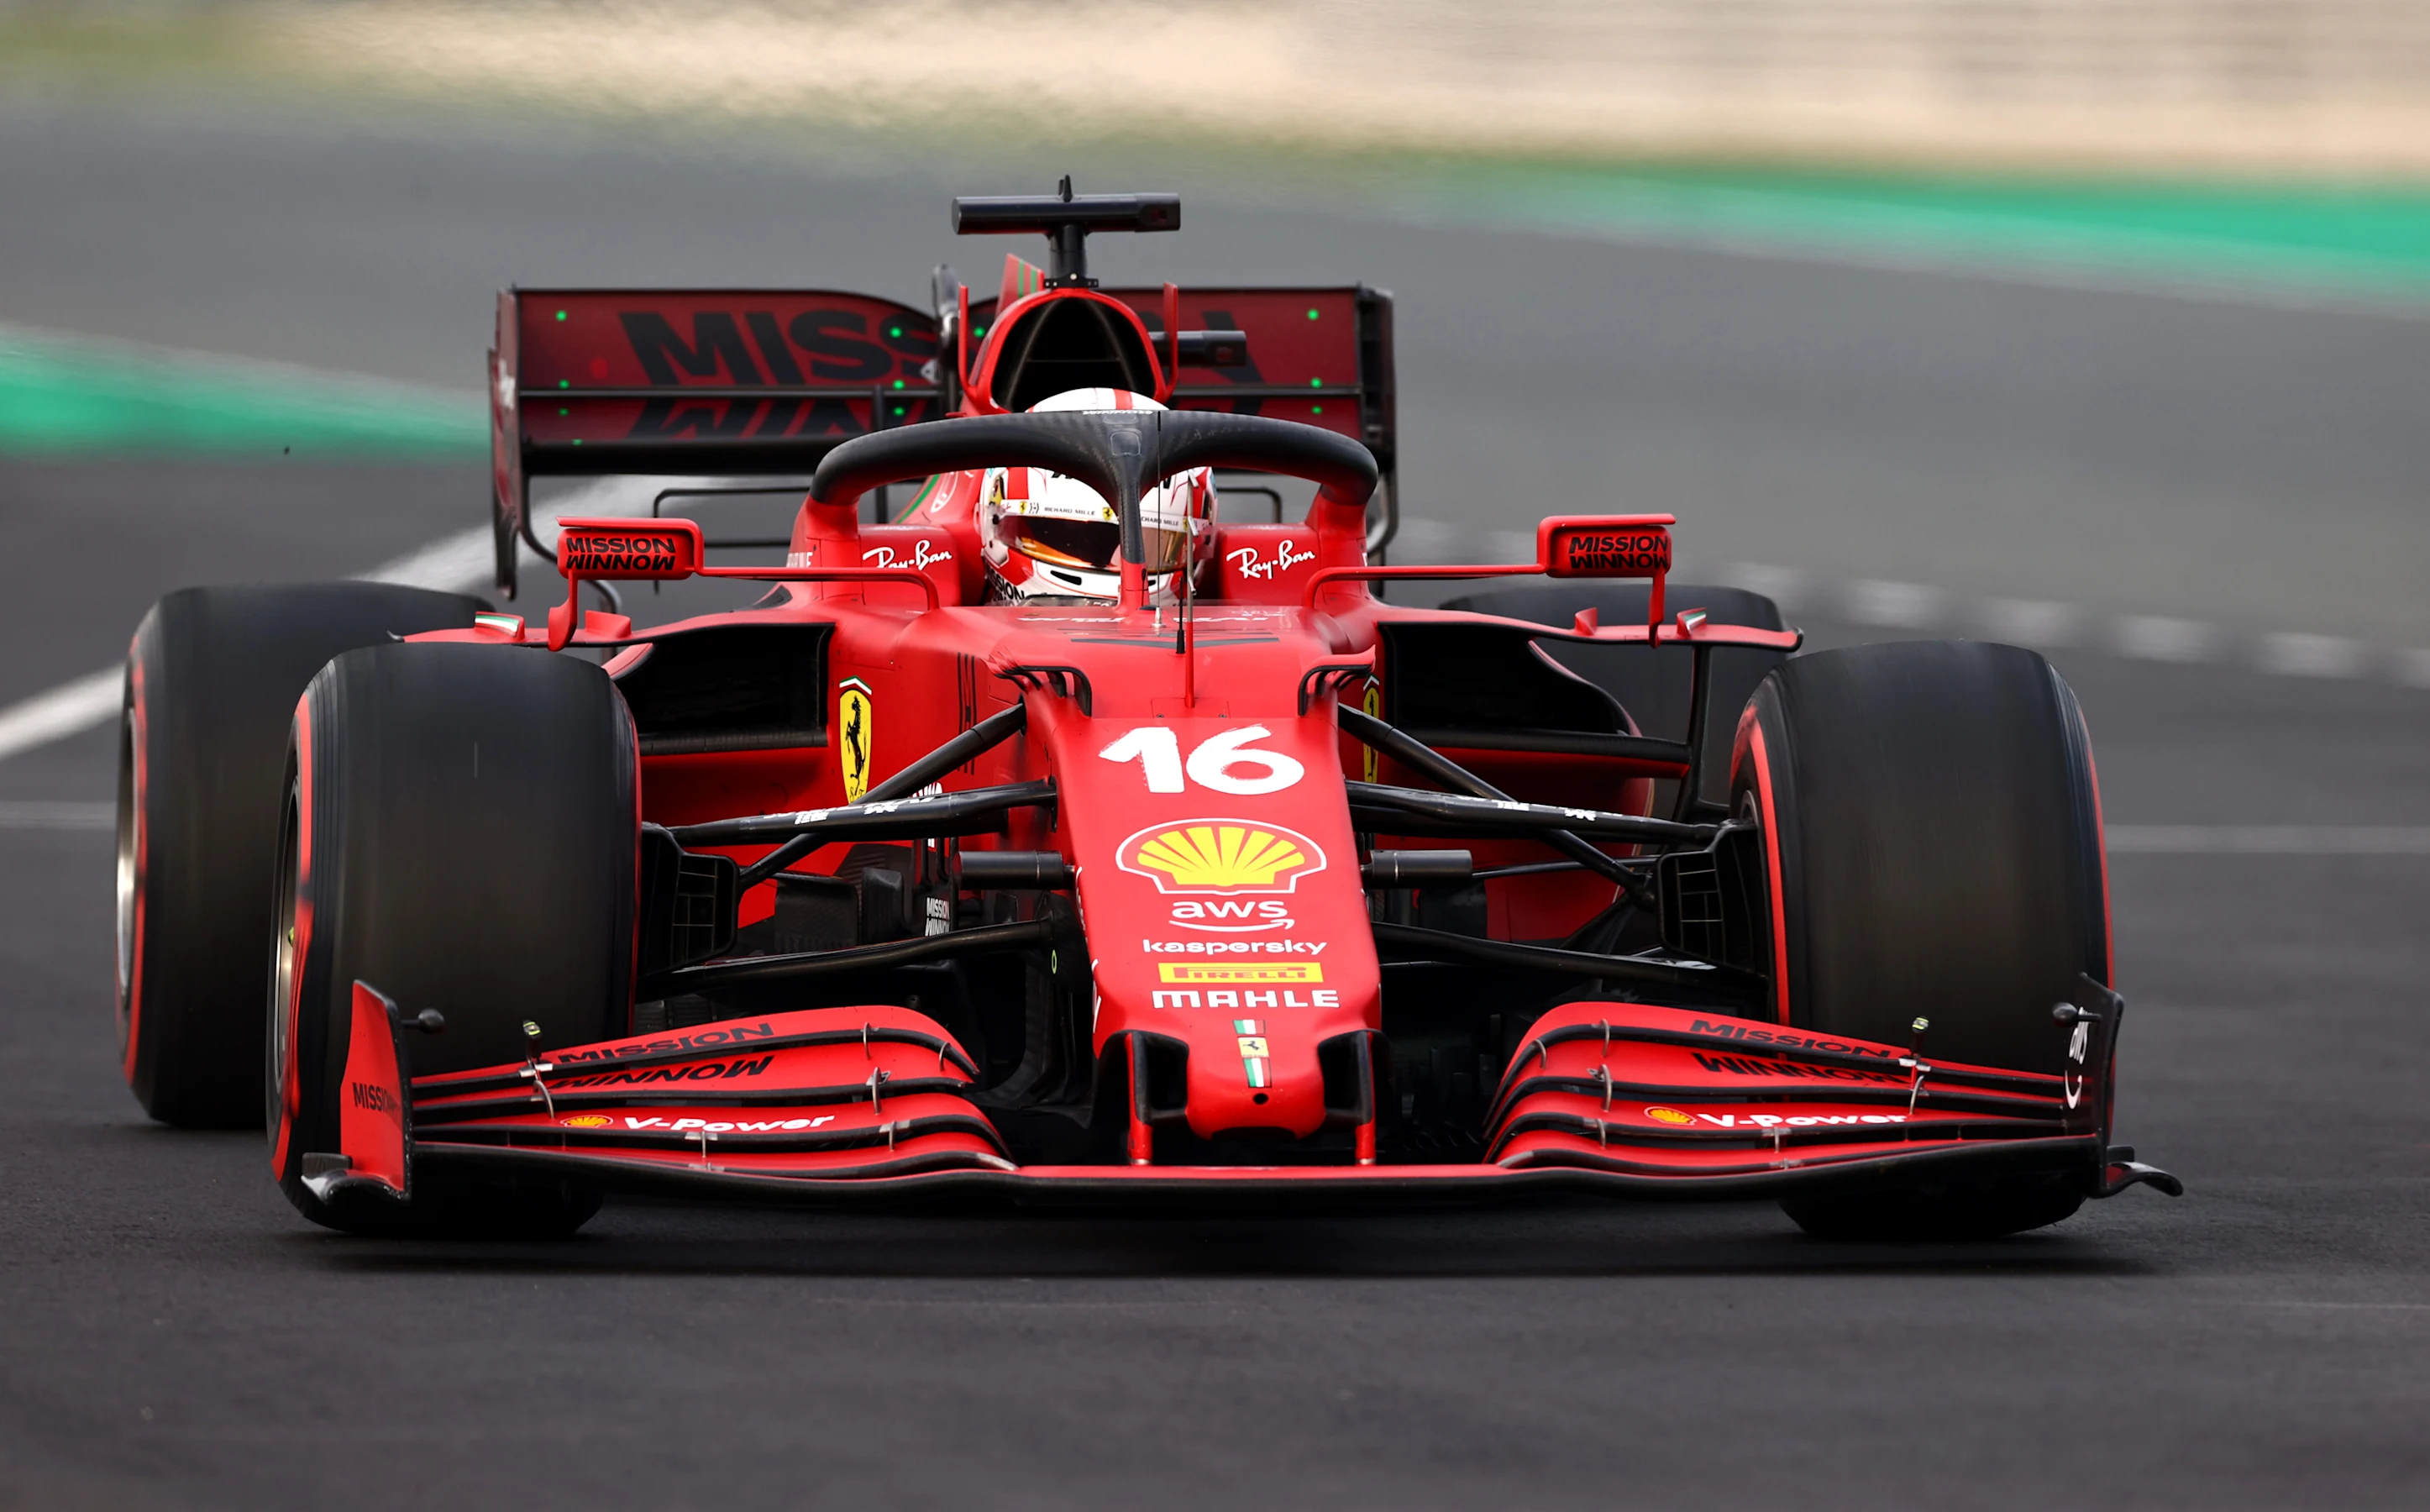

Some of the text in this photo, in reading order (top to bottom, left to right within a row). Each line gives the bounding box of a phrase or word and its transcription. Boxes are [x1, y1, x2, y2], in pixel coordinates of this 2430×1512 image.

[565, 537, 676, 554] MISSION
[1568, 535, 1668, 554] MISSION
[565, 554, 675, 570] WINNOW
[1226, 539, 1315, 580] Ray-Ban
[1569, 553, 1668, 570] WINNOW
[1098, 723, 1305, 795] 16
[926, 896, 950, 921] MISSION
[1172, 900, 1288, 919] aws
[1142, 939, 1327, 955] kaspersky
[1173, 966, 1308, 979] PIRELLI
[1152, 990, 1341, 1009] MAHLE
[558, 1022, 776, 1063] MISSION
[1689, 1019, 1892, 1058] MISSION
[548, 1055, 775, 1089] WINNOW
[1692, 1052, 1913, 1084] WINNOW
[624, 1115, 835, 1132] V-Power
[1697, 1113, 1907, 1127] V-Power
